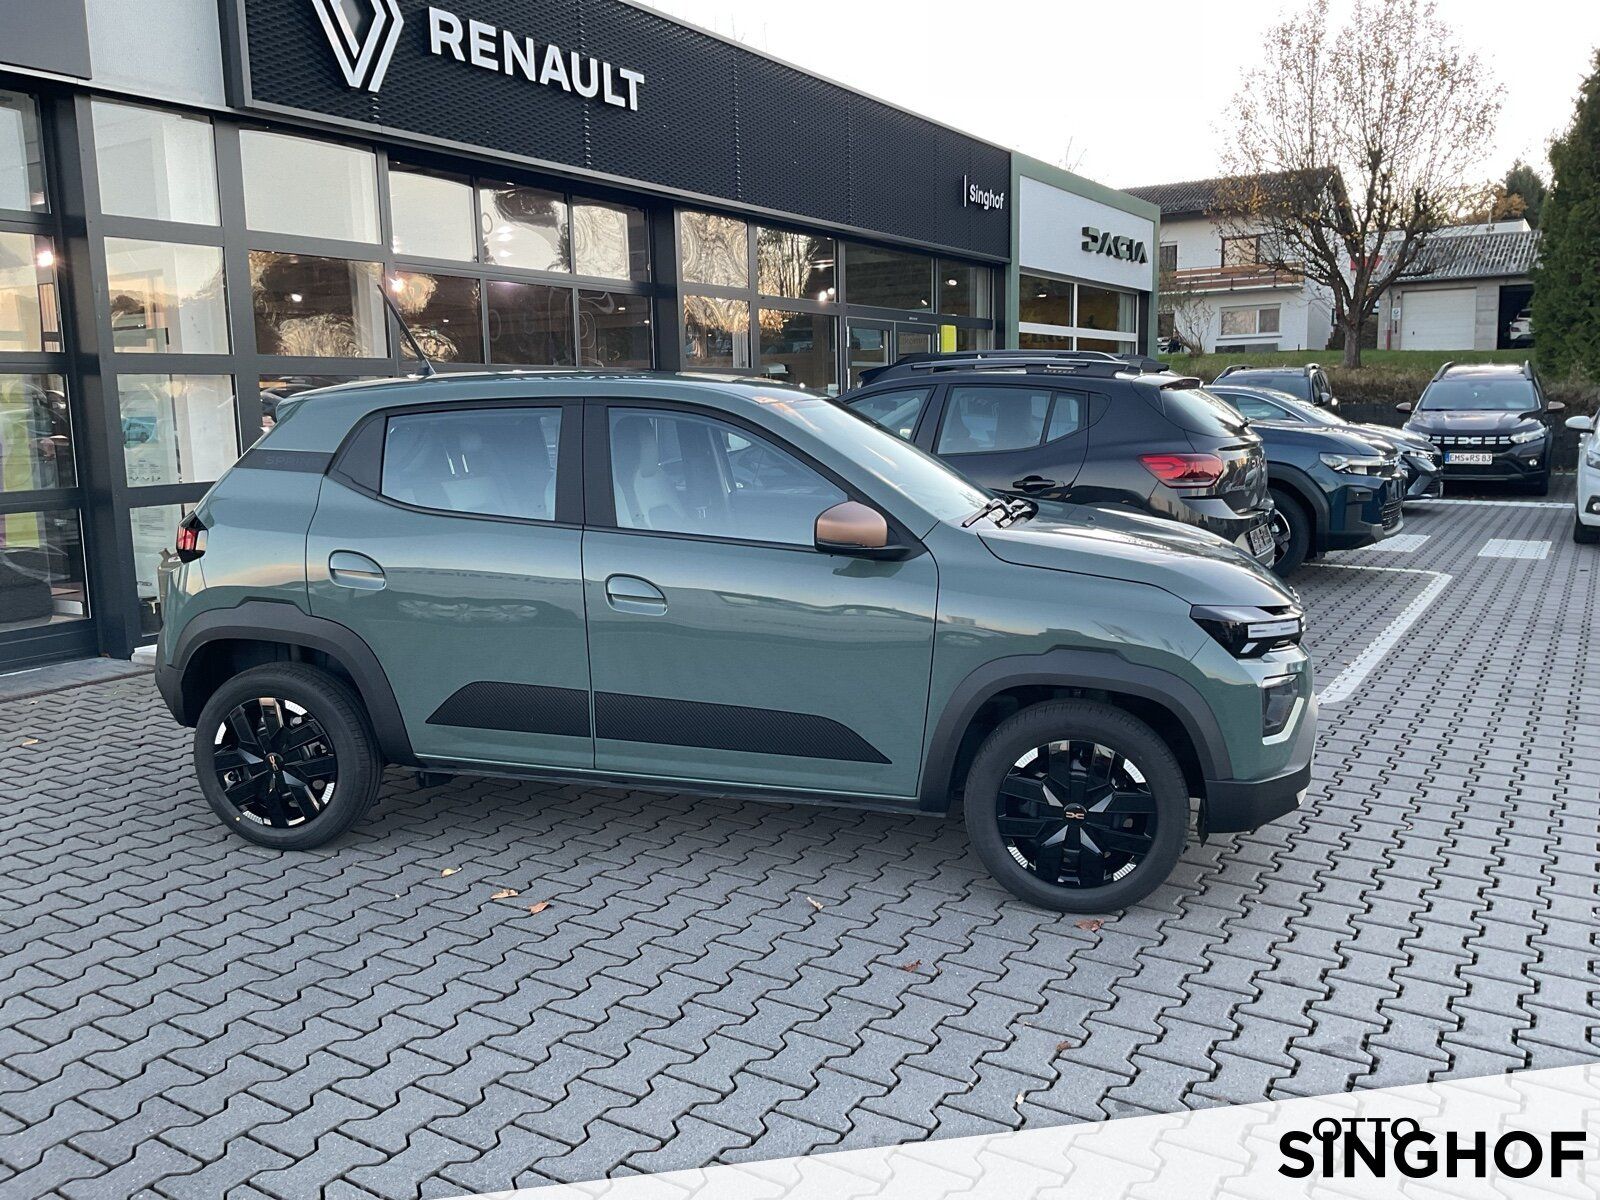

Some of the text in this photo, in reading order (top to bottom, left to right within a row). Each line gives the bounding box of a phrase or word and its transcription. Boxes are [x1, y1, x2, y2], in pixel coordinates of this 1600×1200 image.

[429, 6, 645, 111] RENAULT
[969, 183, 1004, 210] Singhof
[1081, 226, 1148, 264] DACIA
